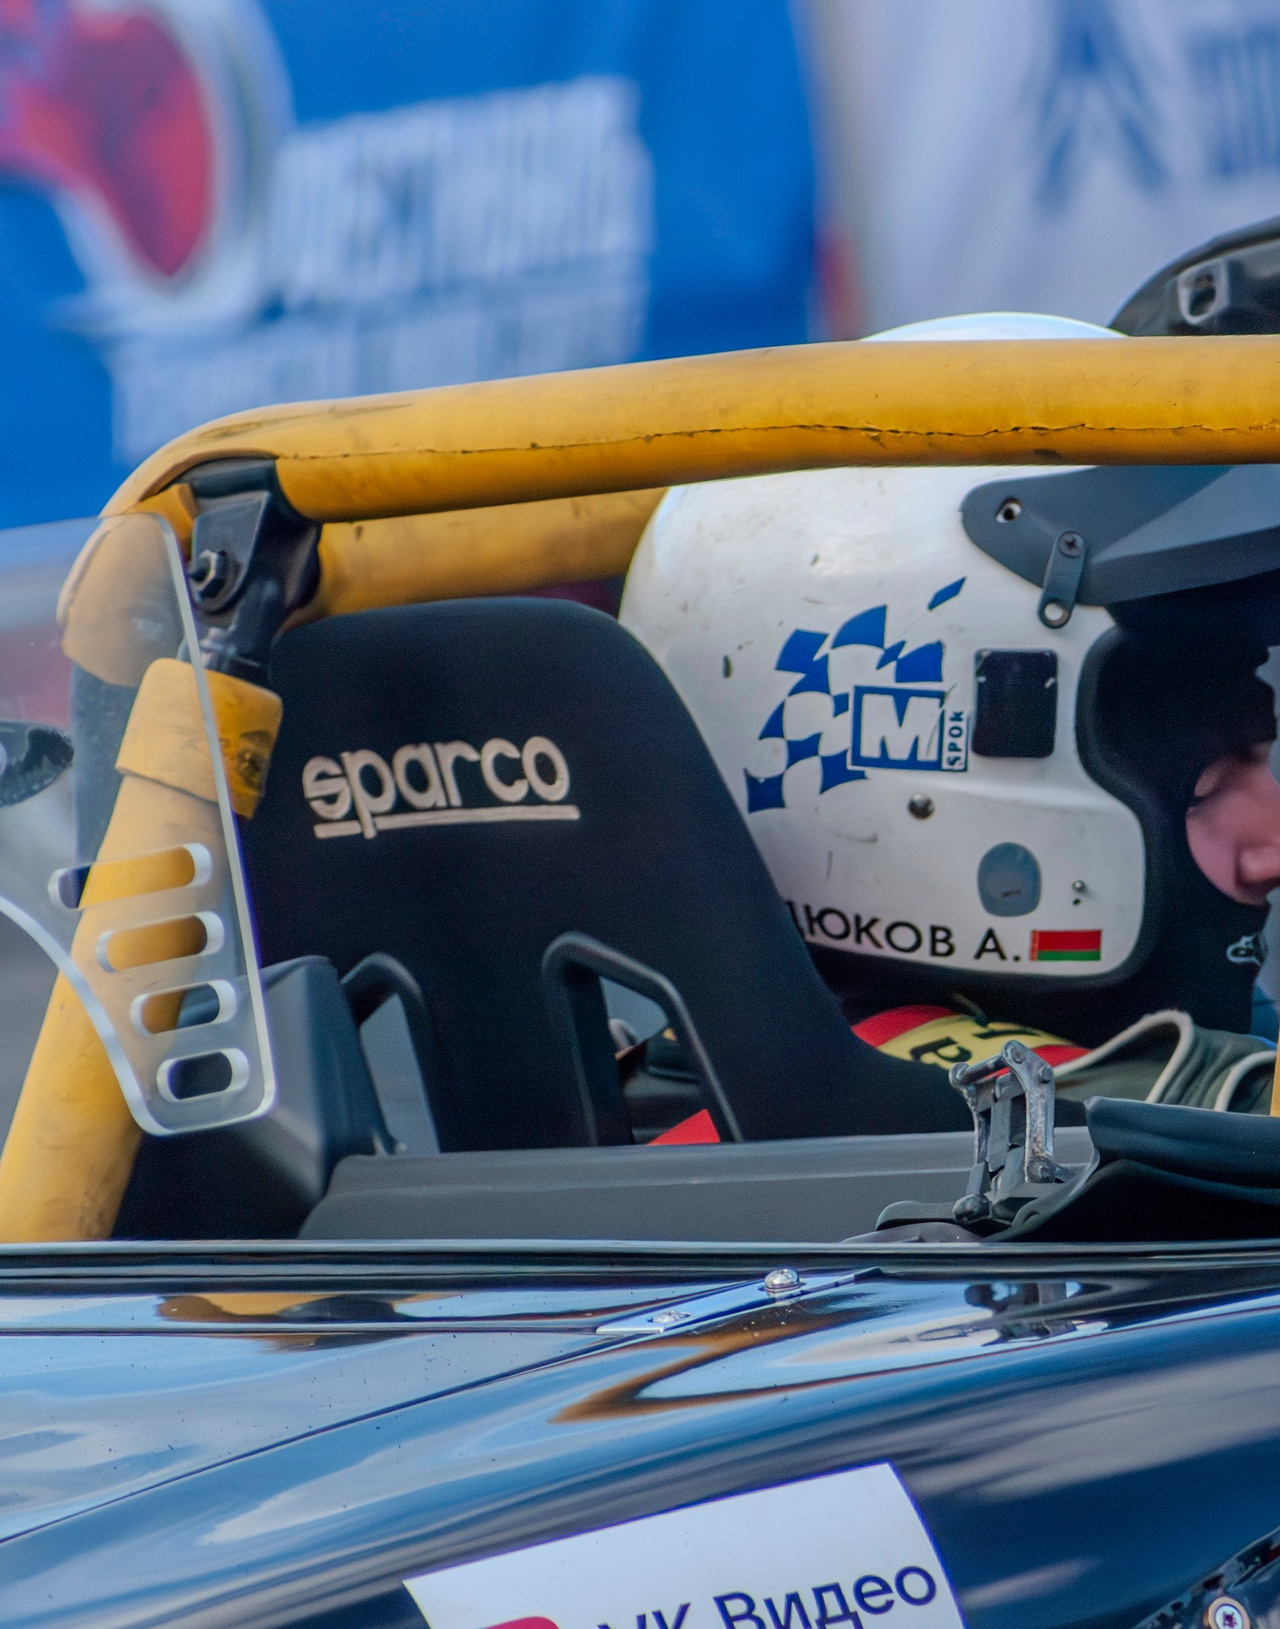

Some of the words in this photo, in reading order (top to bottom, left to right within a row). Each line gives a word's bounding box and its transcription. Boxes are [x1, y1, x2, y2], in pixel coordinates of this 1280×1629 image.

[302, 735, 570, 839] sparco
[974, 927, 1021, 962] А.
[712, 1565, 937, 1629] Видео
